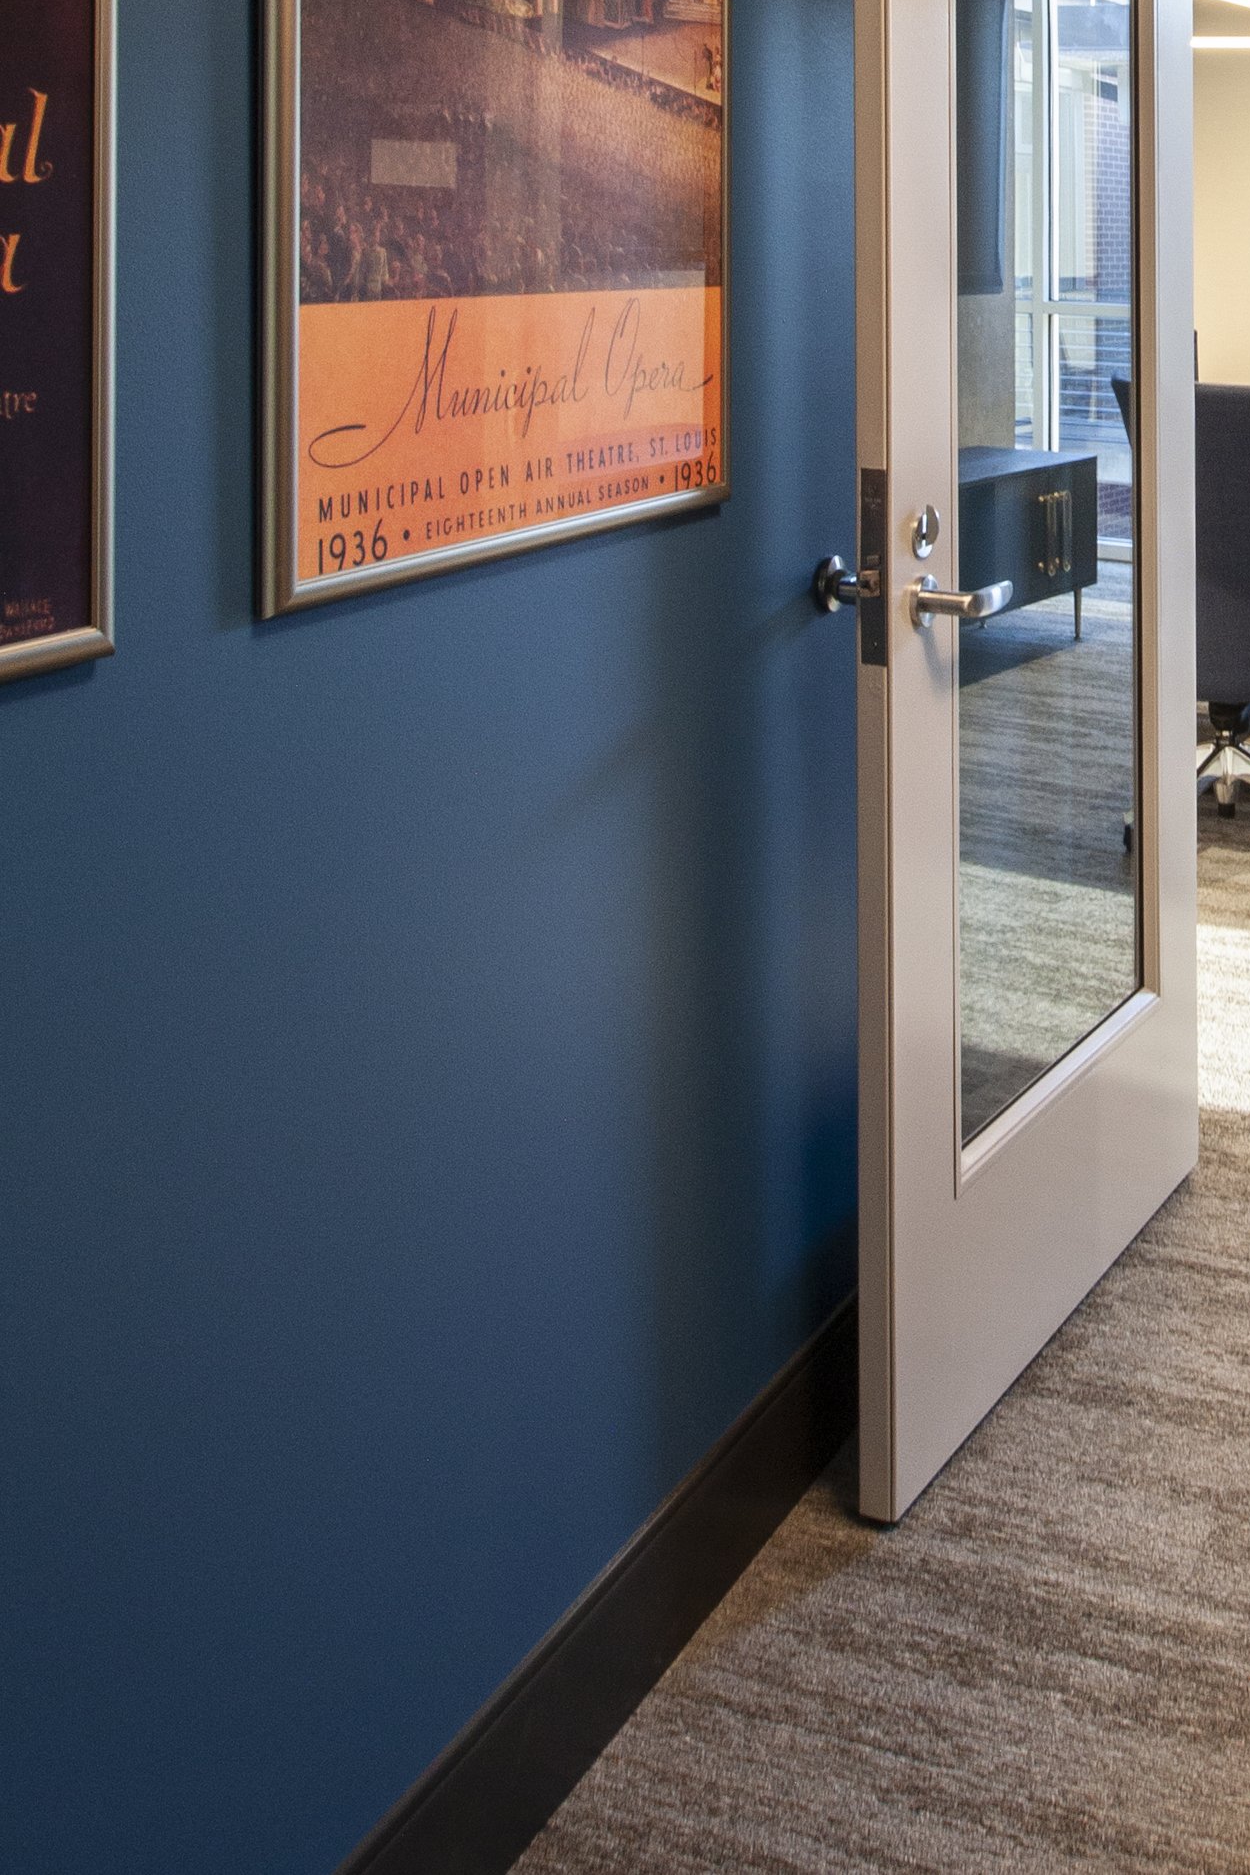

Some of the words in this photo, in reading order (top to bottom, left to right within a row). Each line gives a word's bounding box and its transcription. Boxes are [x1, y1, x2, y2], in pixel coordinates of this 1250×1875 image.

[308, 305, 595, 468] Municipal
[604, 296, 713, 421] Opera
[318, 518, 388, 575] 1936
[426, 502, 527, 540] EIGHTEENTH
[536, 488, 592, 515] ANNUAL
[598, 476, 649, 502] SEASON
[674, 450, 717, 493] 1936
[319, 476, 445, 524] MUNICIPAL
[460, 464, 509, 495] OPEN
[525, 456, 553, 482] AIR
[566, 441, 640, 474] THEATRE,
[649, 435, 668, 458] ST.
[675, 426, 717, 453] LOUIS
